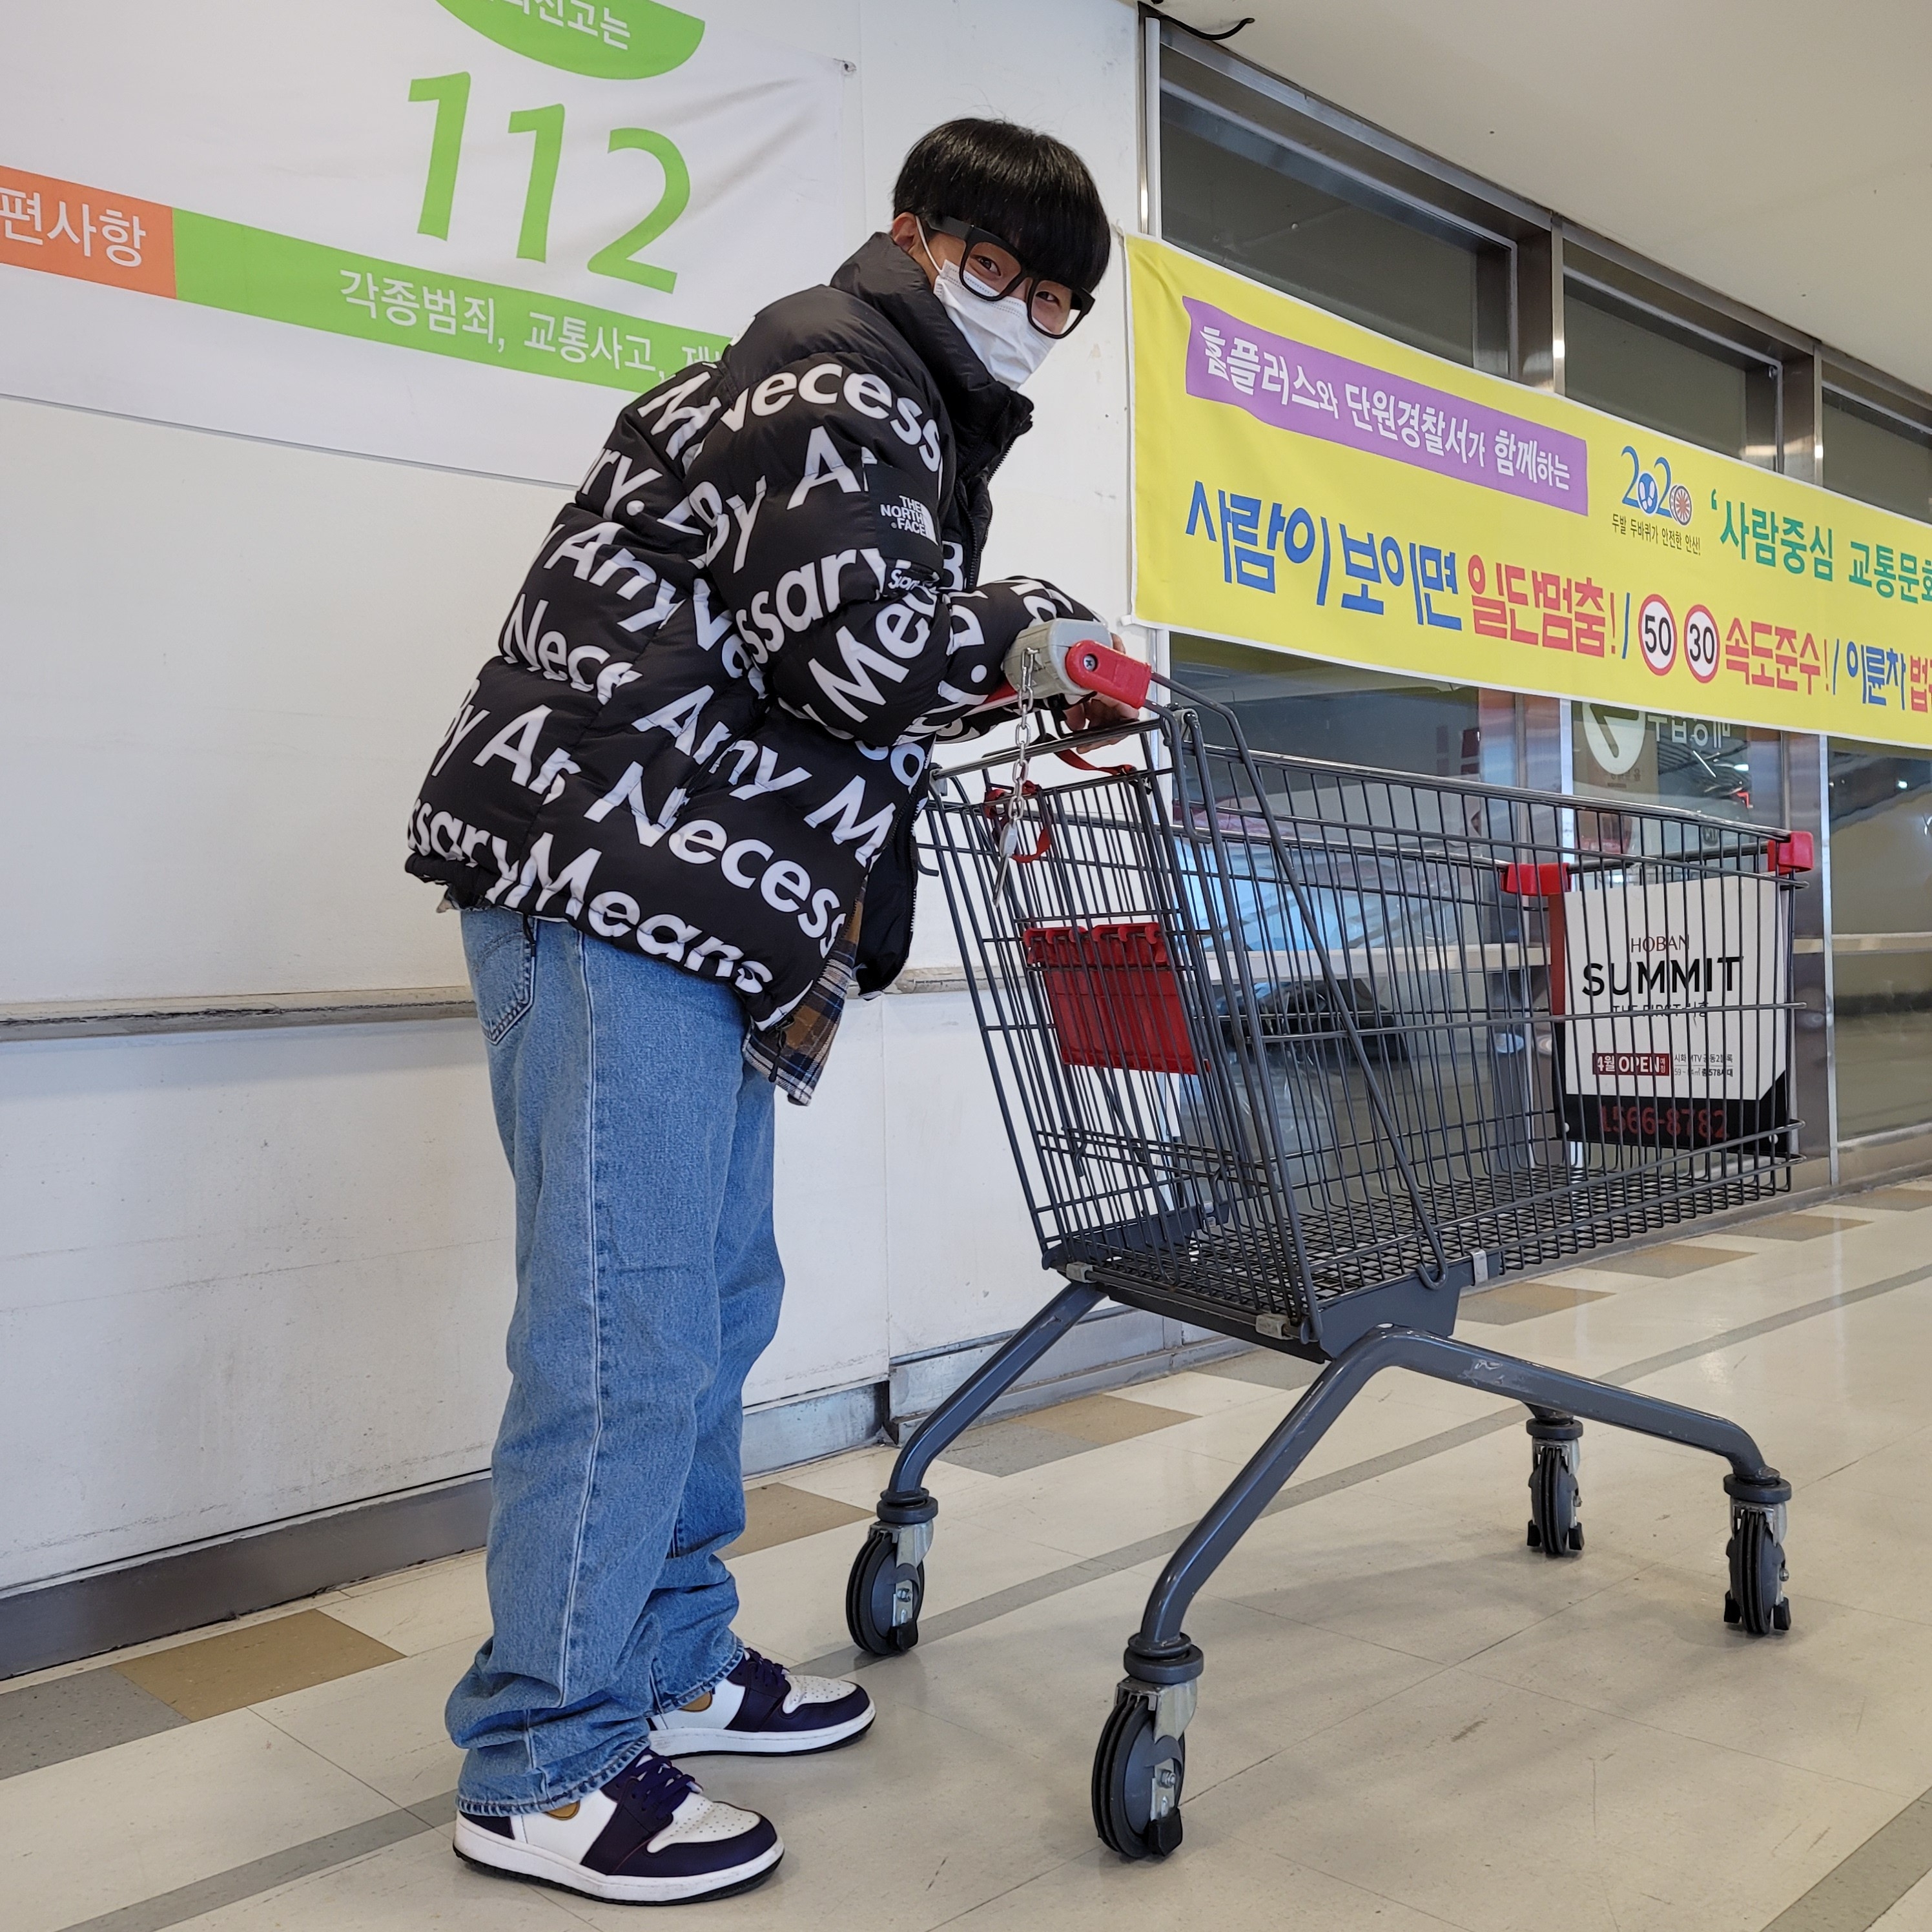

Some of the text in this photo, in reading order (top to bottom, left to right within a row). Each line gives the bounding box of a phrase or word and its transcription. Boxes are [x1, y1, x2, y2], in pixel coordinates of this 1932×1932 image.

[407, 71, 691, 294] 112
[340, 269, 505, 353] 각종범죄,
[1199, 325, 1570, 491] 홈플러스와 단원경찰서가 함께하는
[879, 504, 924, 524] NORTH
[899, 495, 921, 513] THE
[896, 517, 927, 537] FACE
[1645, 613, 1671, 657] 50
[1689, 623, 1715, 665] 30
[1630, 934, 1690, 953] HOBAN
[1582, 956, 1744, 996] SUMMIT
